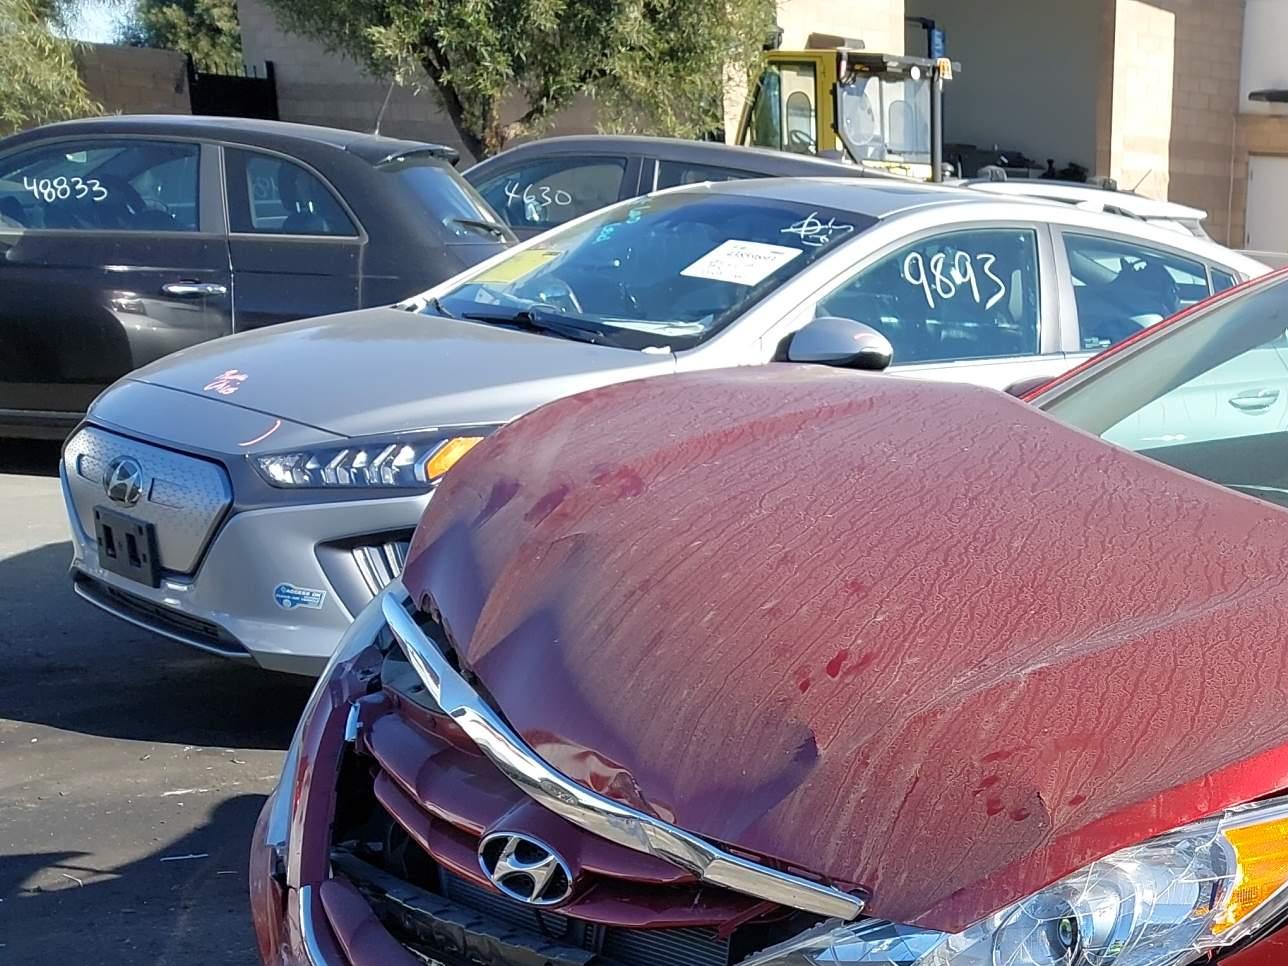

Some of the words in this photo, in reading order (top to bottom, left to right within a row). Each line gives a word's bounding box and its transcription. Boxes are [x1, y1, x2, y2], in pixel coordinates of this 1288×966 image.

[23, 176, 108, 203] 48833
[504, 180, 572, 208] 4630
[903, 250, 1006, 311] 9893
